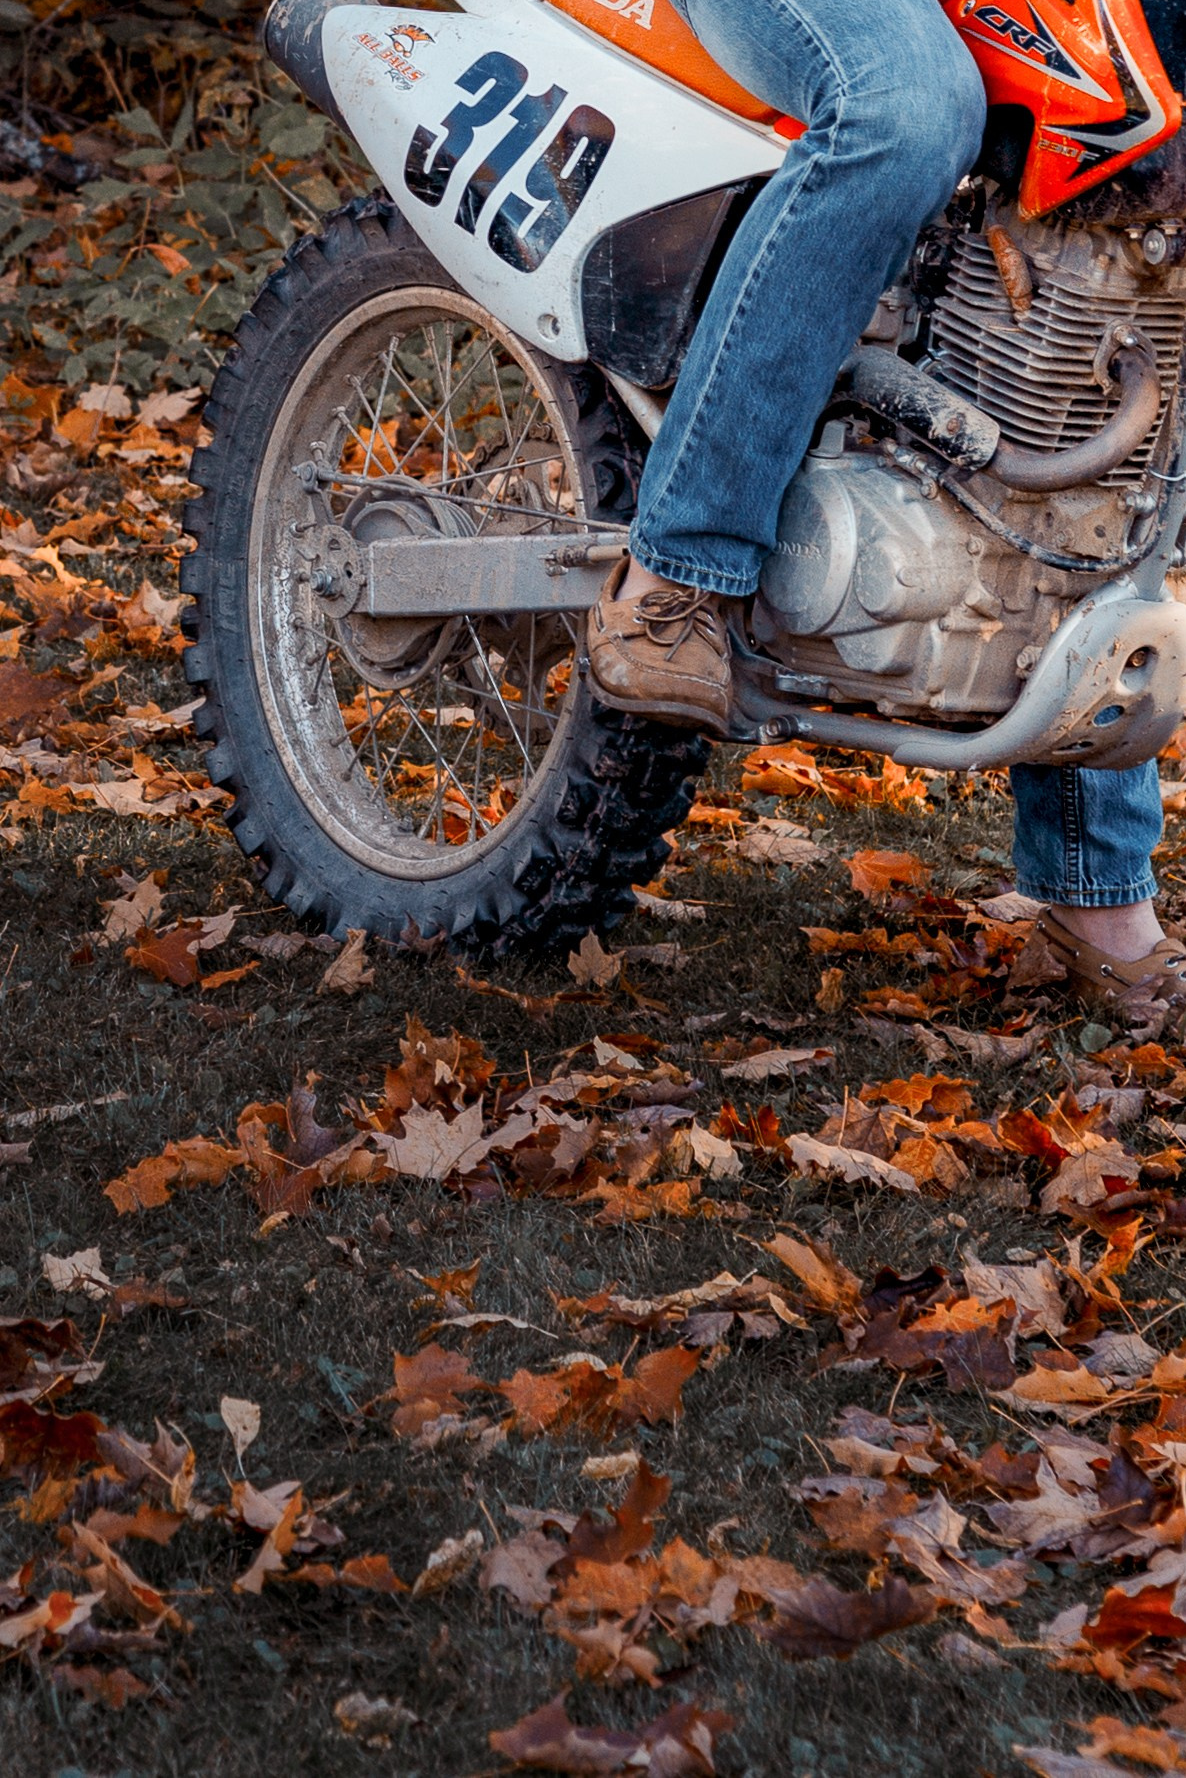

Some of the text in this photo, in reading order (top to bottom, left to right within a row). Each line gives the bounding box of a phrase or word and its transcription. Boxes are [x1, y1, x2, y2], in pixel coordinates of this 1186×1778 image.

[973, 5, 1057, 56] CRF
[353, 33, 425, 81] ALL BALLS
[404, 51, 616, 272] 319
